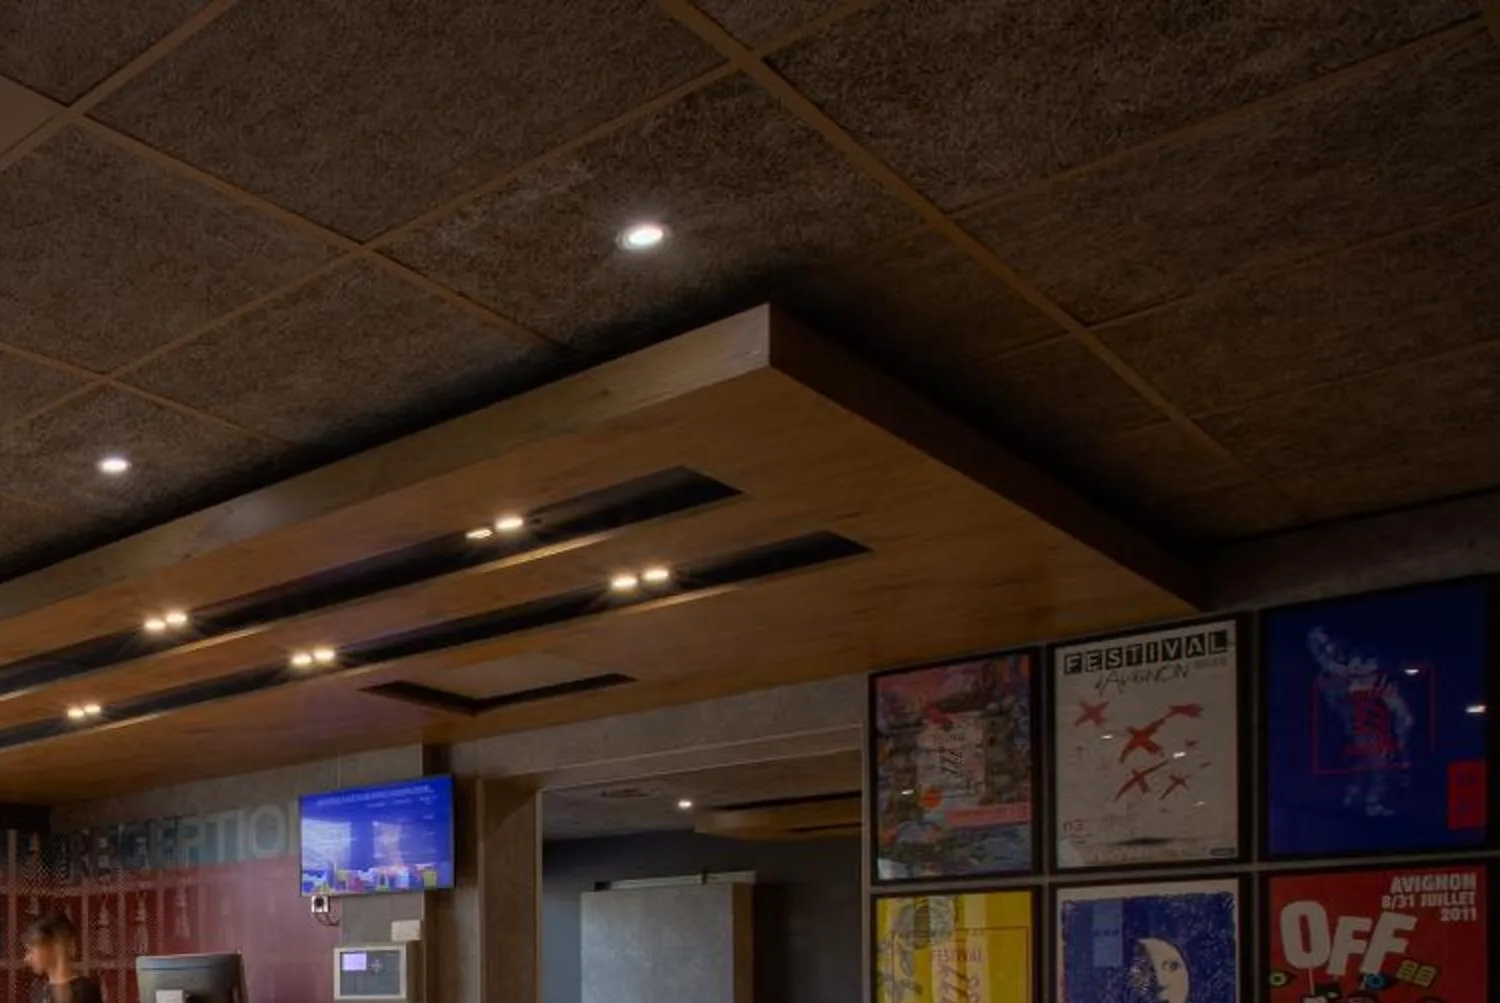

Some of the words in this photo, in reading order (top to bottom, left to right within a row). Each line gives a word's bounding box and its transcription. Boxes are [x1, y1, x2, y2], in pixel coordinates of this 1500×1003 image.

[1063, 630, 1228, 674] FESTIVAL
[67, 803, 298, 876] RECEPTIO
[1390, 872, 1477, 893] AVIGNON
[1420, 890, 1476, 907] JUILLET
[1440, 906, 1477, 922] 2011
[1281, 900, 1419, 976] OFF
